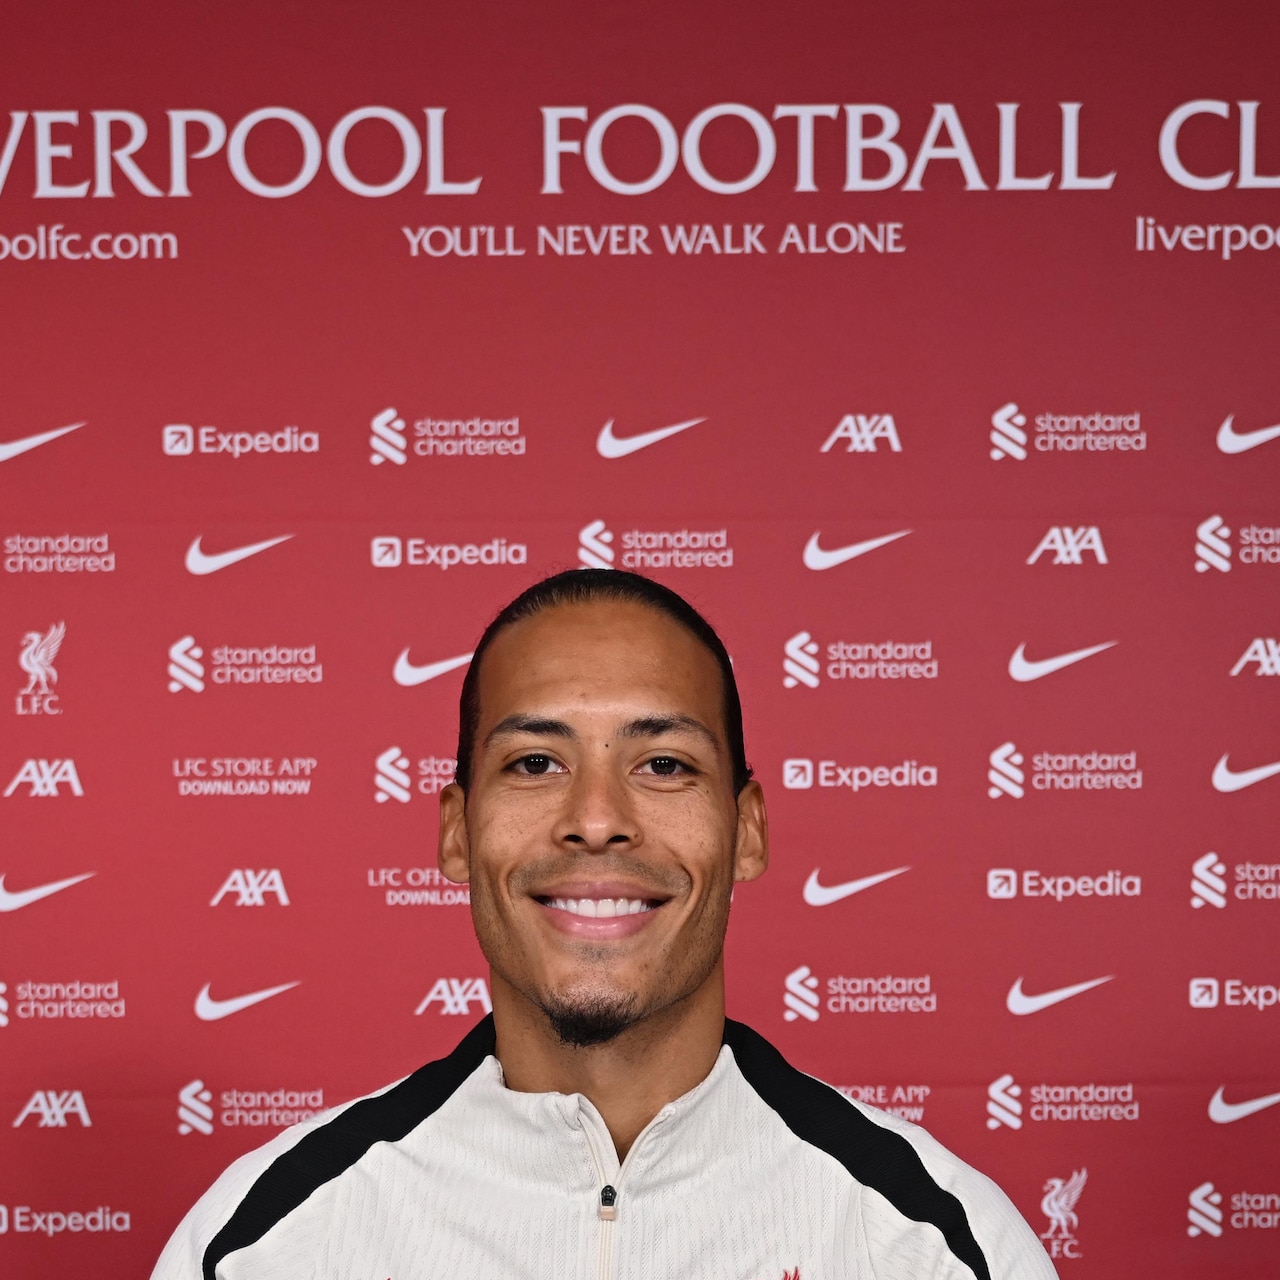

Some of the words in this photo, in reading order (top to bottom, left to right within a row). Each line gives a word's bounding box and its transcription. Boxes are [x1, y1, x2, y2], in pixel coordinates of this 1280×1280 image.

[541, 102, 1116, 195] FOOTBALL
[402, 225, 525, 257] YOU'LL
[537, 224, 652, 256] NEVER
[660, 223, 765, 255] WALK
[778, 222, 907, 254] ALONE
[413, 417, 520, 437] standard
[1034, 412, 1141, 432] standard
[198, 426, 320, 459] Expedia
[820, 414, 903, 453] AXA
[1034, 431, 1147, 452] chartered
[413, 436, 527, 457] chartered
[621, 529, 728, 549] standard
[406, 538, 528, 571] Expedia
[622, 548, 734, 568] chartered
[172, 758, 207, 777] LFC
[211, 757, 275, 777] STORE
[278, 757, 318, 776] APP
[818, 760, 938, 792] Expedia
[178, 779, 271, 796] DOWNLOAD
[271, 778, 312, 795] NOW
[210, 868, 290, 907] AXA
[15, 980, 120, 1000] standard
[827, 974, 931, 994] standard
[15, 999, 126, 1019] chartered
[826, 993, 937, 1013] chartered
[12, 1090, 92, 1128] AXA
[13, 1205, 131, 1237] Expedia
